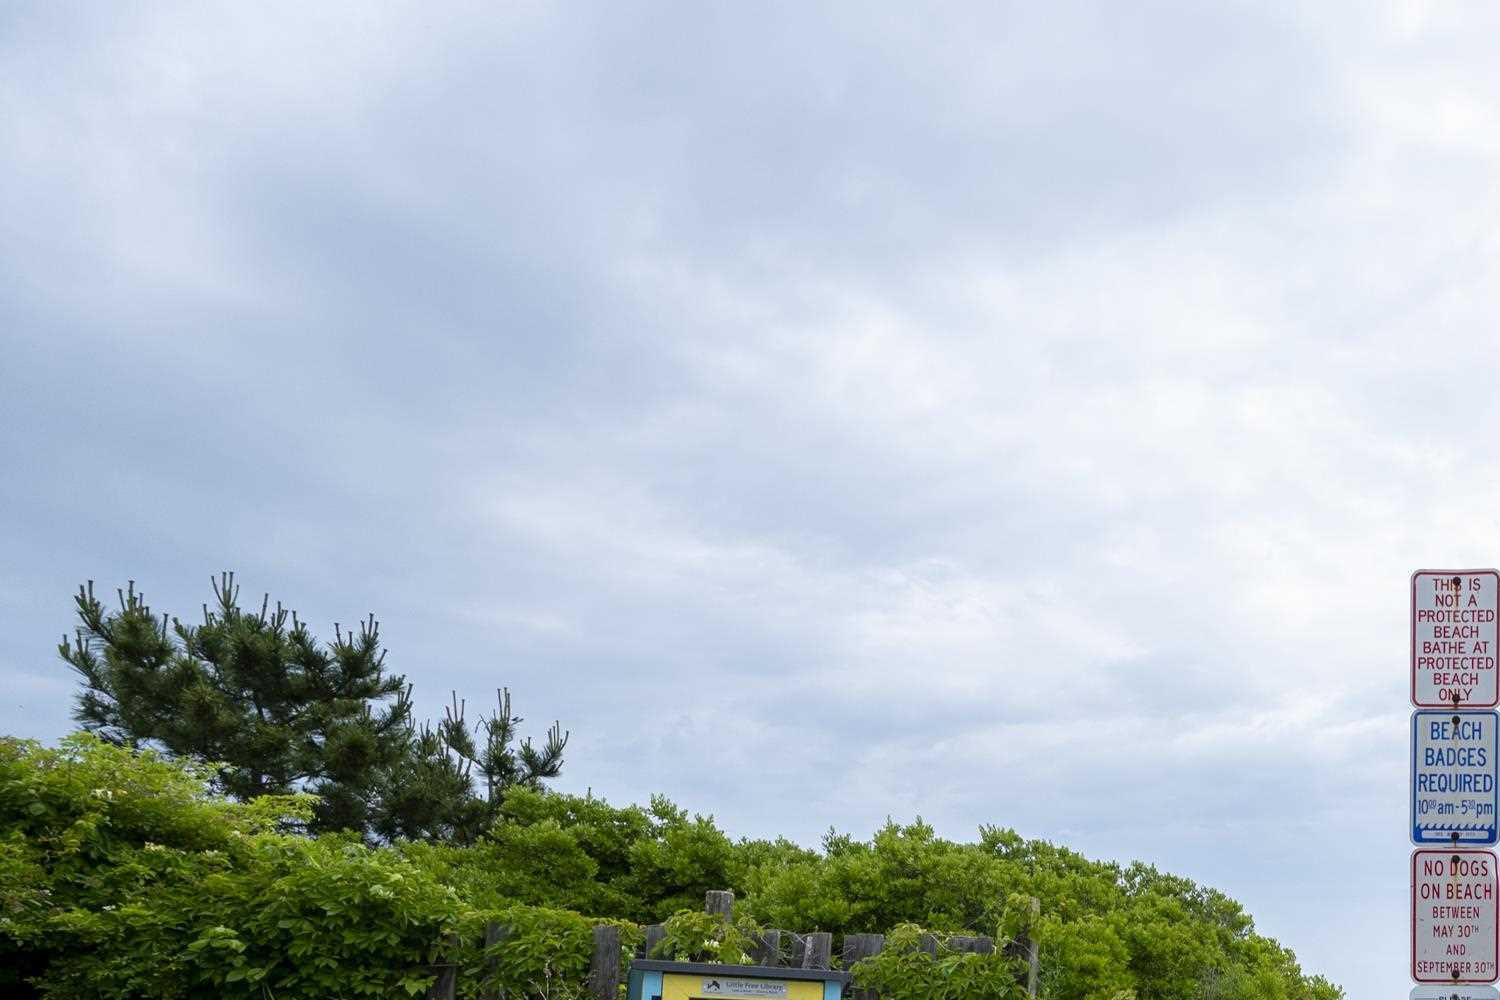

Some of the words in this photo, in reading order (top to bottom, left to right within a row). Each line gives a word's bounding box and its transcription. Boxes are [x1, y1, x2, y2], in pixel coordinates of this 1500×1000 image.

[1469, 578, 1481, 591] IS
[1435, 594, 1461, 607] NOT
[1468, 594, 1477, 607] A
[1418, 610, 1494, 622] PROTECTED
[1434, 626, 1479, 638] BEACH
[1423, 641, 1466, 654] BATHE
[1473, 641, 1489, 654] AT
[1418, 657, 1494, 669] PROTECTED
[1433, 672, 1478, 685] BEACH
[1439, 688, 1472, 701] ONLY
[1431, 721, 1481, 740] BEACH
[1425, 747, 1487, 766] BADGES
[1418, 774, 1493, 792] REQUIRED
[1424, 860, 1443, 876] NO
[1450, 860, 1488, 876] DOGS
[1421, 883, 1440, 899] ON
[1446, 883, 1492, 899] BEACH
[1432, 906, 1479, 919] BETWEEN
[1433, 925, 1455, 937] MAY
[1446, 944, 1466, 955] AND
[1417, 961, 1471, 973] SEPTEMBER
